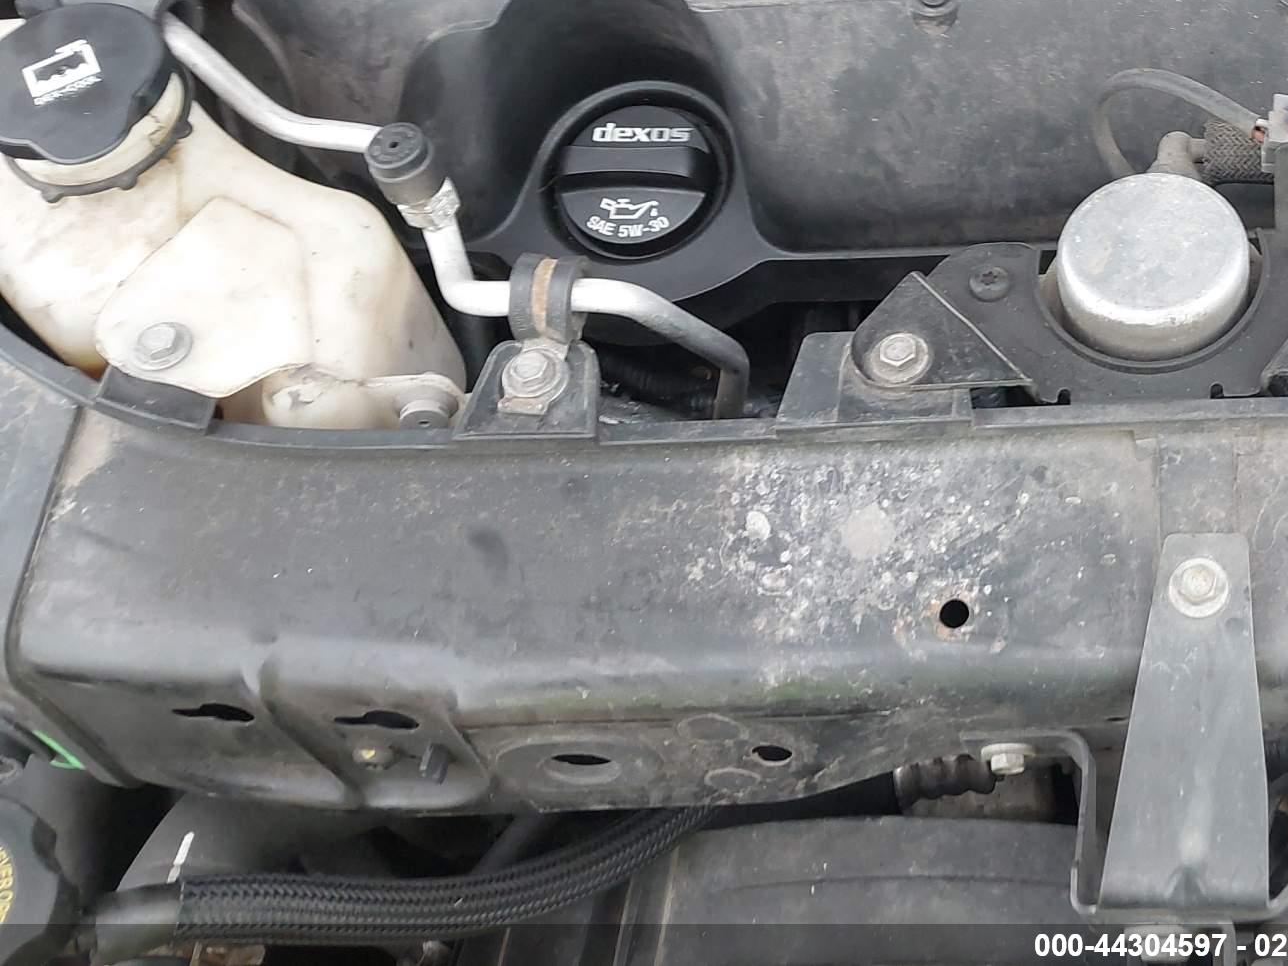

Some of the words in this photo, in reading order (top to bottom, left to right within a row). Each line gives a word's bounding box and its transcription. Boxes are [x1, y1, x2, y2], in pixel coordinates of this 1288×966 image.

[592, 122, 696, 143] dexos
[586, 215, 615, 236] SAE
[617, 215, 670, 237] 5W-30
